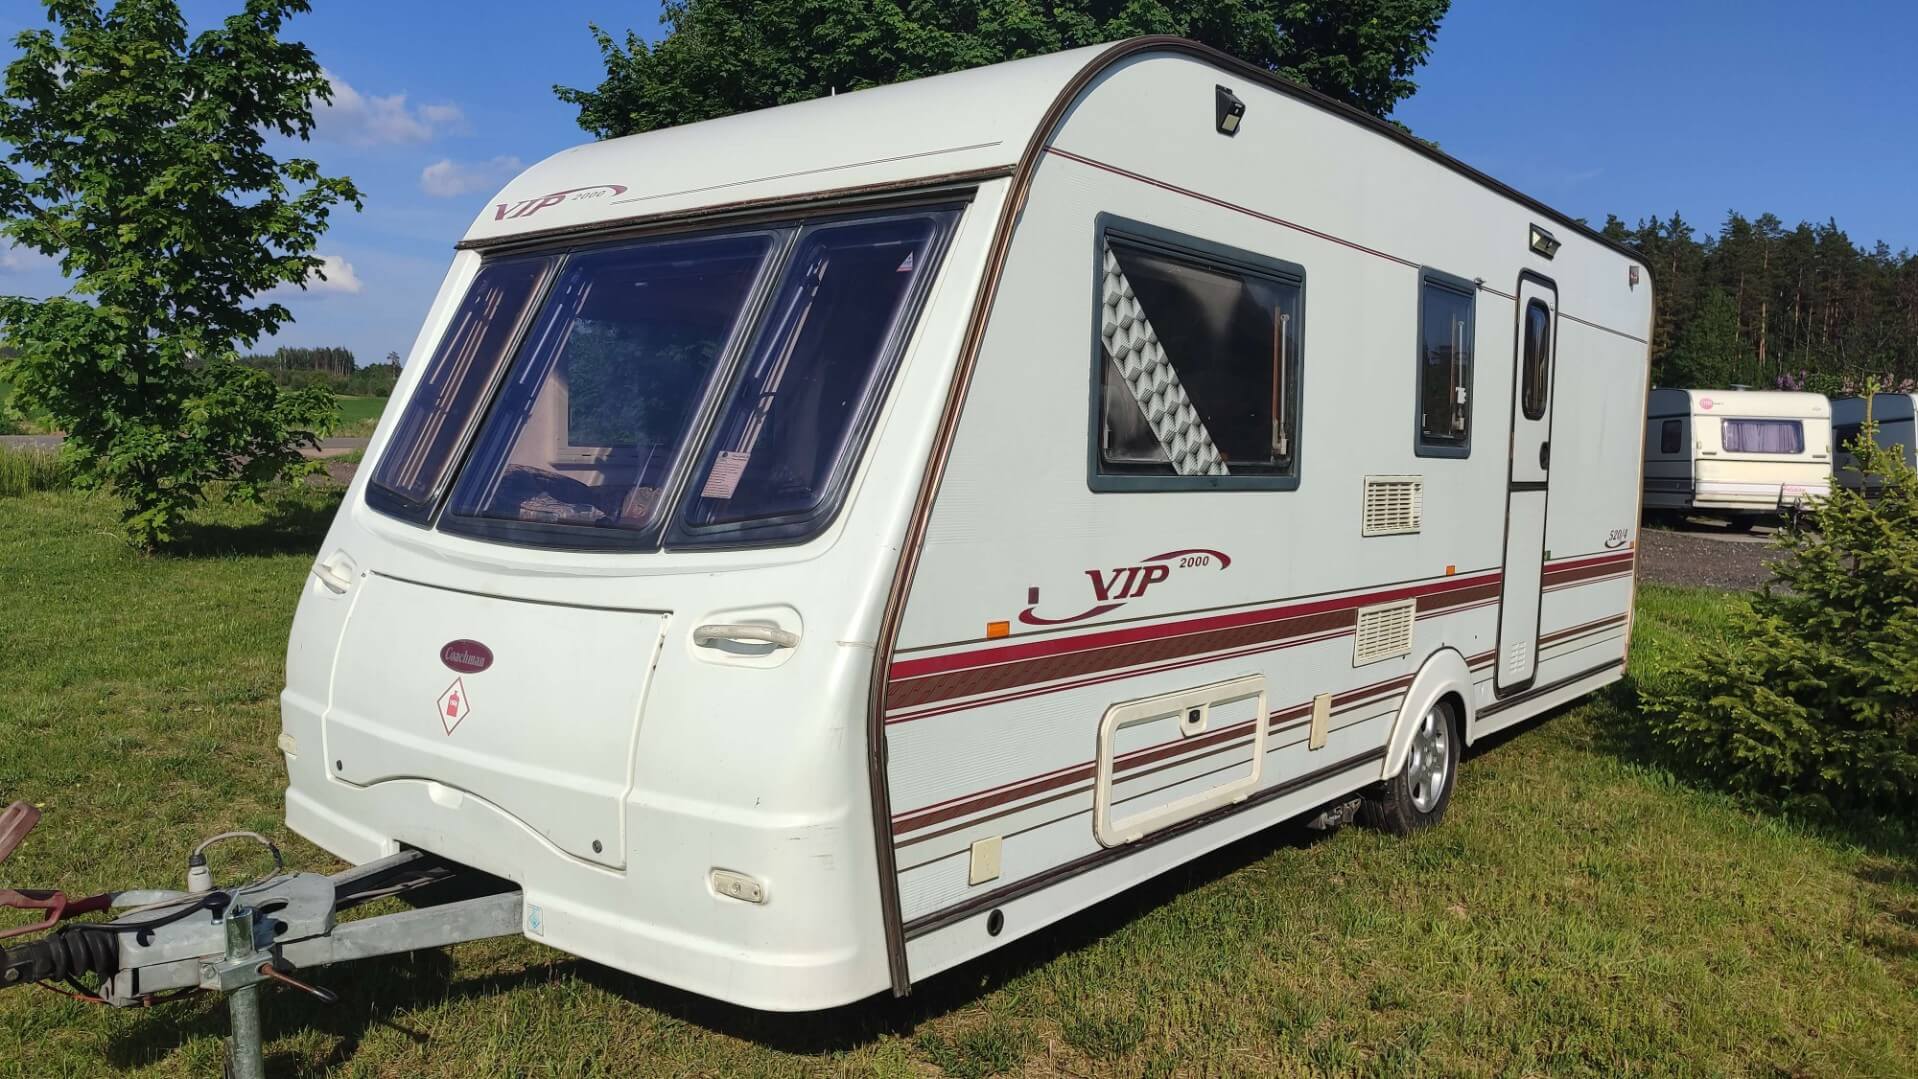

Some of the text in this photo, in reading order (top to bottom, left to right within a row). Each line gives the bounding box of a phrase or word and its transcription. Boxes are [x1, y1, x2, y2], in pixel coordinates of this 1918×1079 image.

[495, 190, 606, 221] VIP 2000
[1084, 556, 1209, 601] VIP 2000
[445, 646, 485, 667] Coachman
